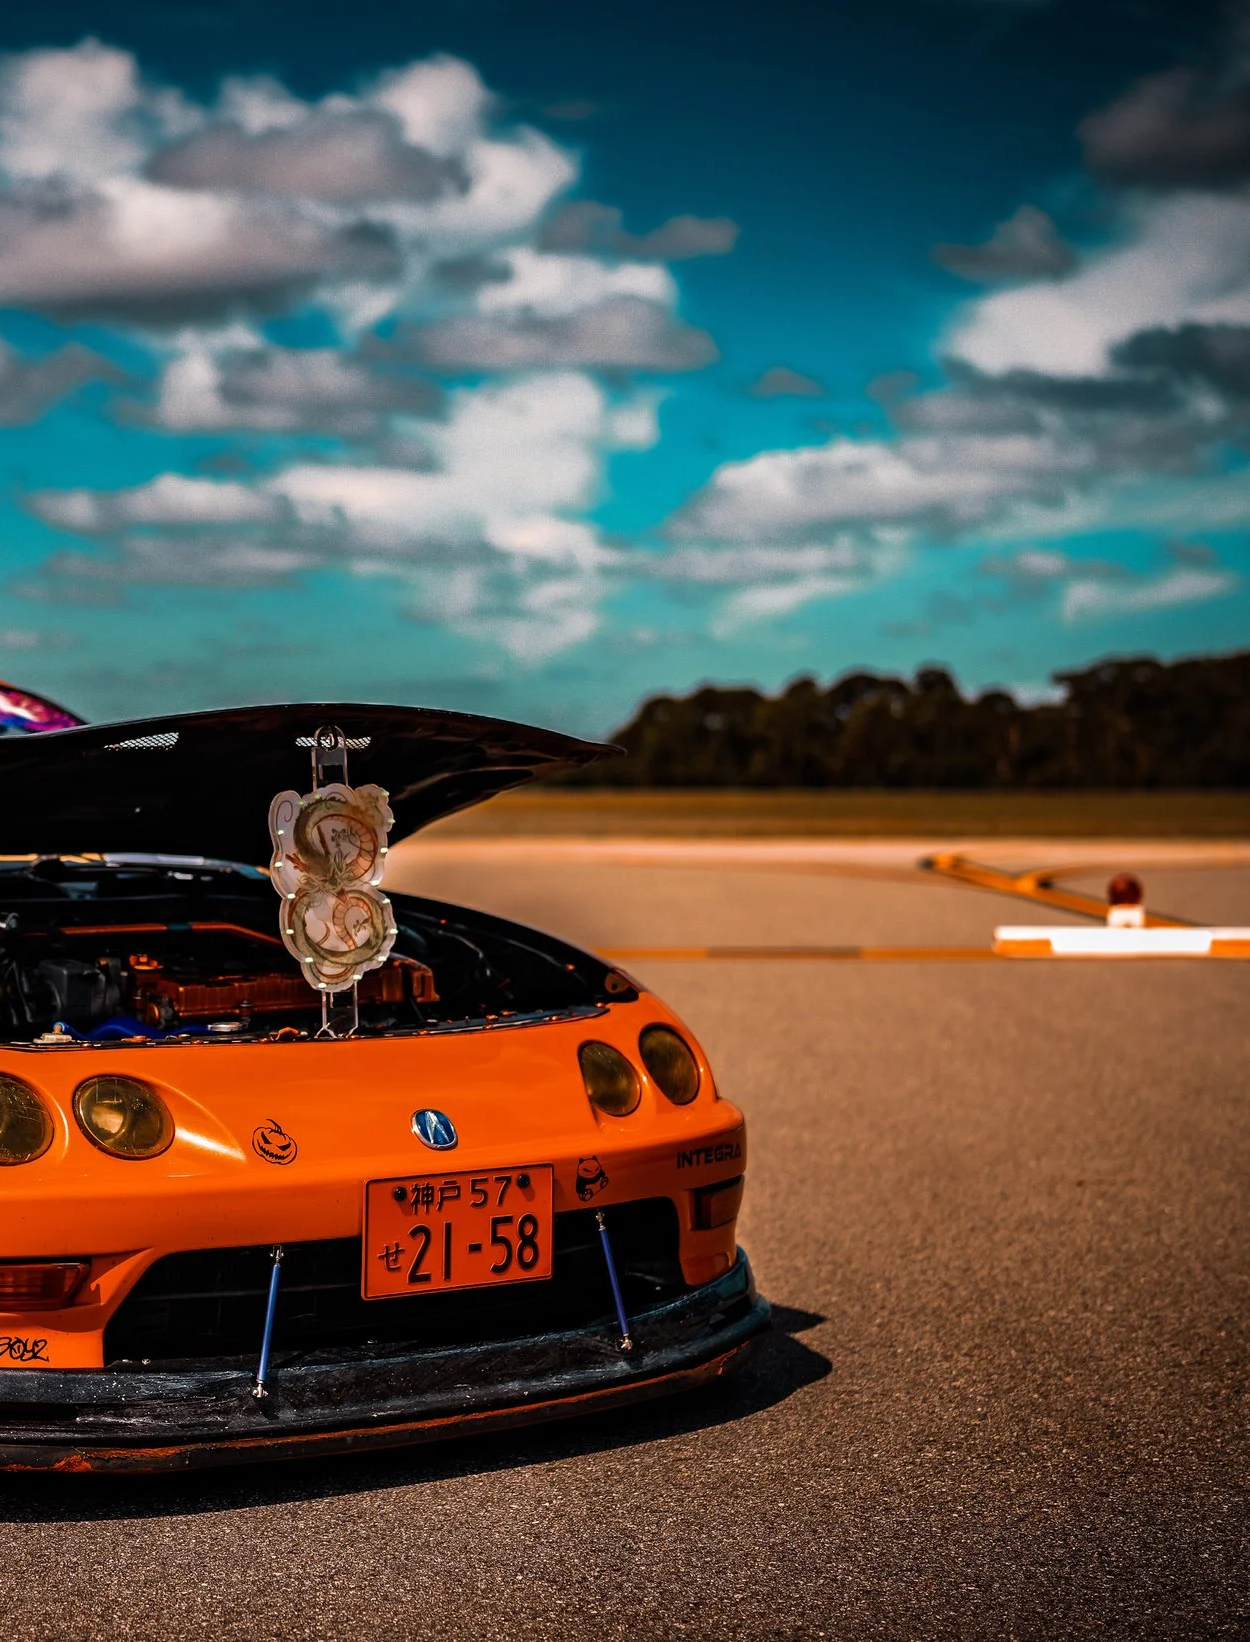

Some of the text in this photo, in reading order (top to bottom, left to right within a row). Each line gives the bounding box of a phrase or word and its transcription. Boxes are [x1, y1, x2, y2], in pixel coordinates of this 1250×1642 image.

[676, 1142, 742, 1169] INTEGRA
[409, 1175, 513, 1215] 神戸 57
[378, 1213, 539, 1284] せ 21-58
